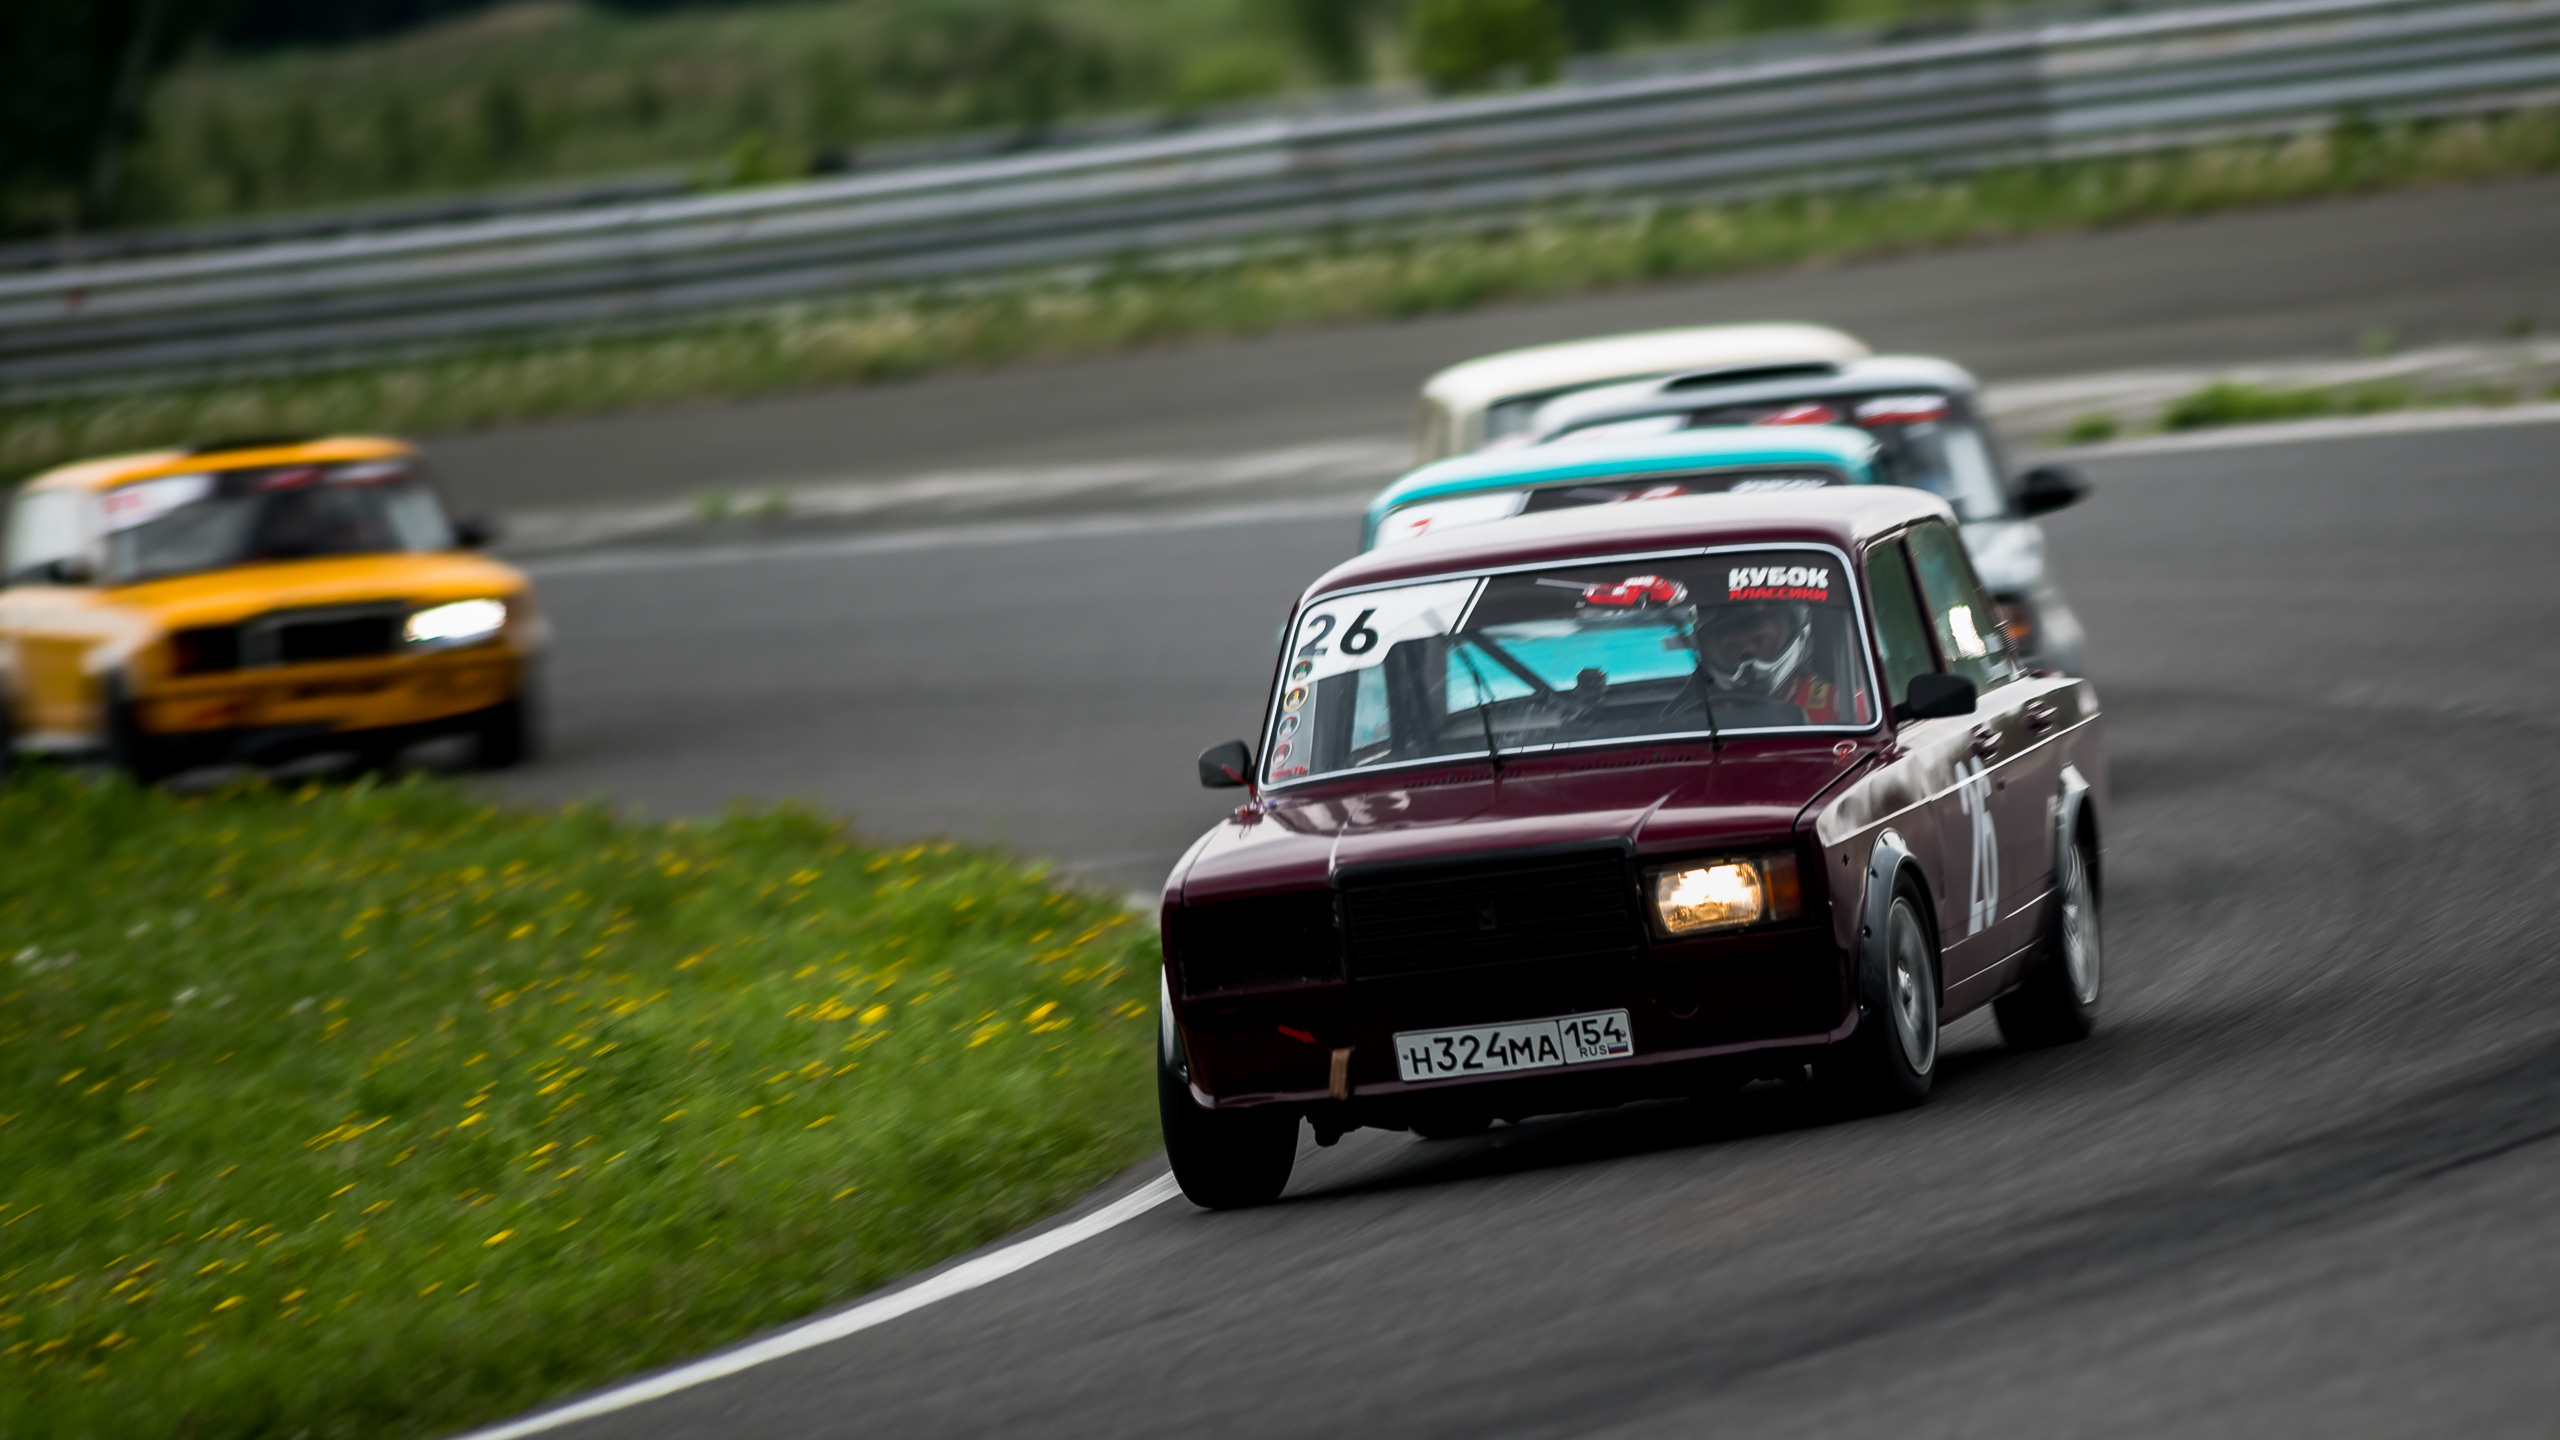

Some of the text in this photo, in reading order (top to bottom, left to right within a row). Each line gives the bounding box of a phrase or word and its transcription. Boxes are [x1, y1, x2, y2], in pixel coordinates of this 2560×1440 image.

[1728, 566, 1829, 591] КУБОК
[1297, 608, 1379, 657] 26
[1954, 755, 1999, 936] 26
[1409, 1016, 1622, 1075] Н324МА 154
[1579, 1045, 1608, 1058] RUS
